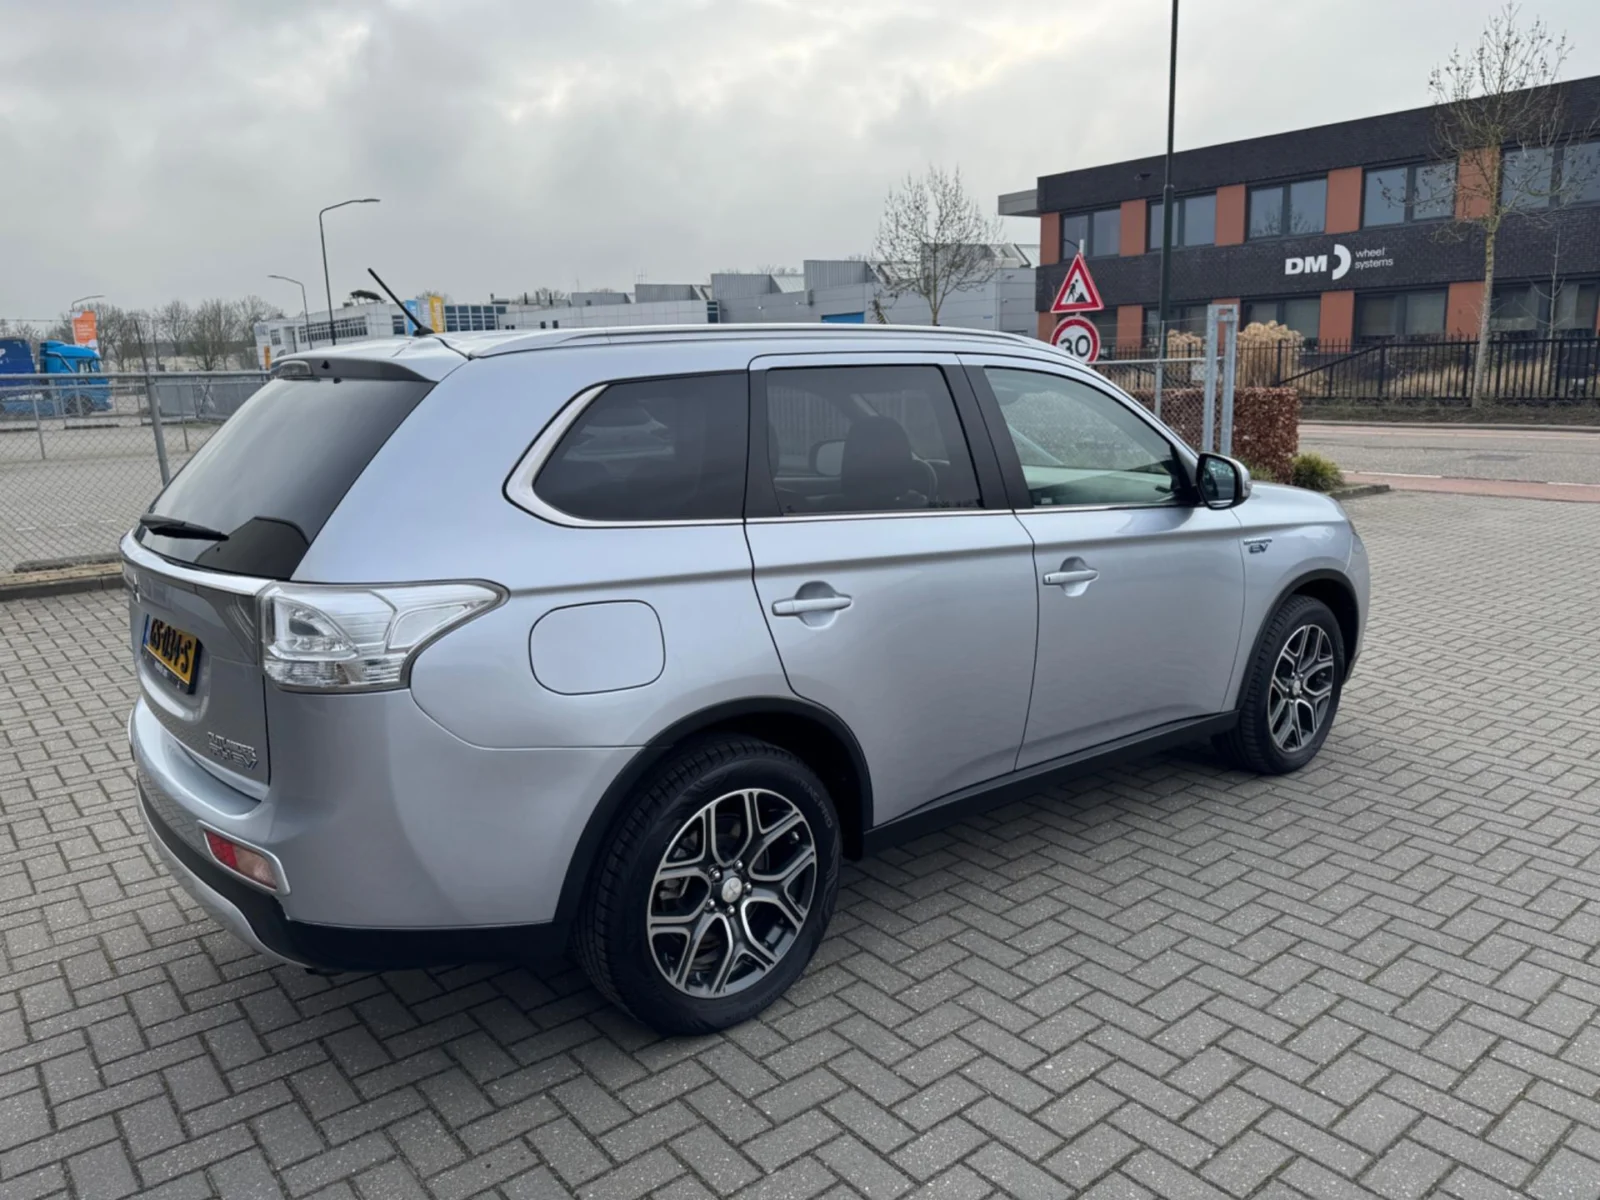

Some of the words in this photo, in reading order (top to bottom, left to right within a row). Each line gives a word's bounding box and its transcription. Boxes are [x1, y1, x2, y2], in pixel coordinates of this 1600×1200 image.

[1355, 247, 1386, 258] wheel
[1284, 254, 1328, 275] DM
[1355, 258, 1394, 270] systems
[1060, 335, 1091, 357] 30
